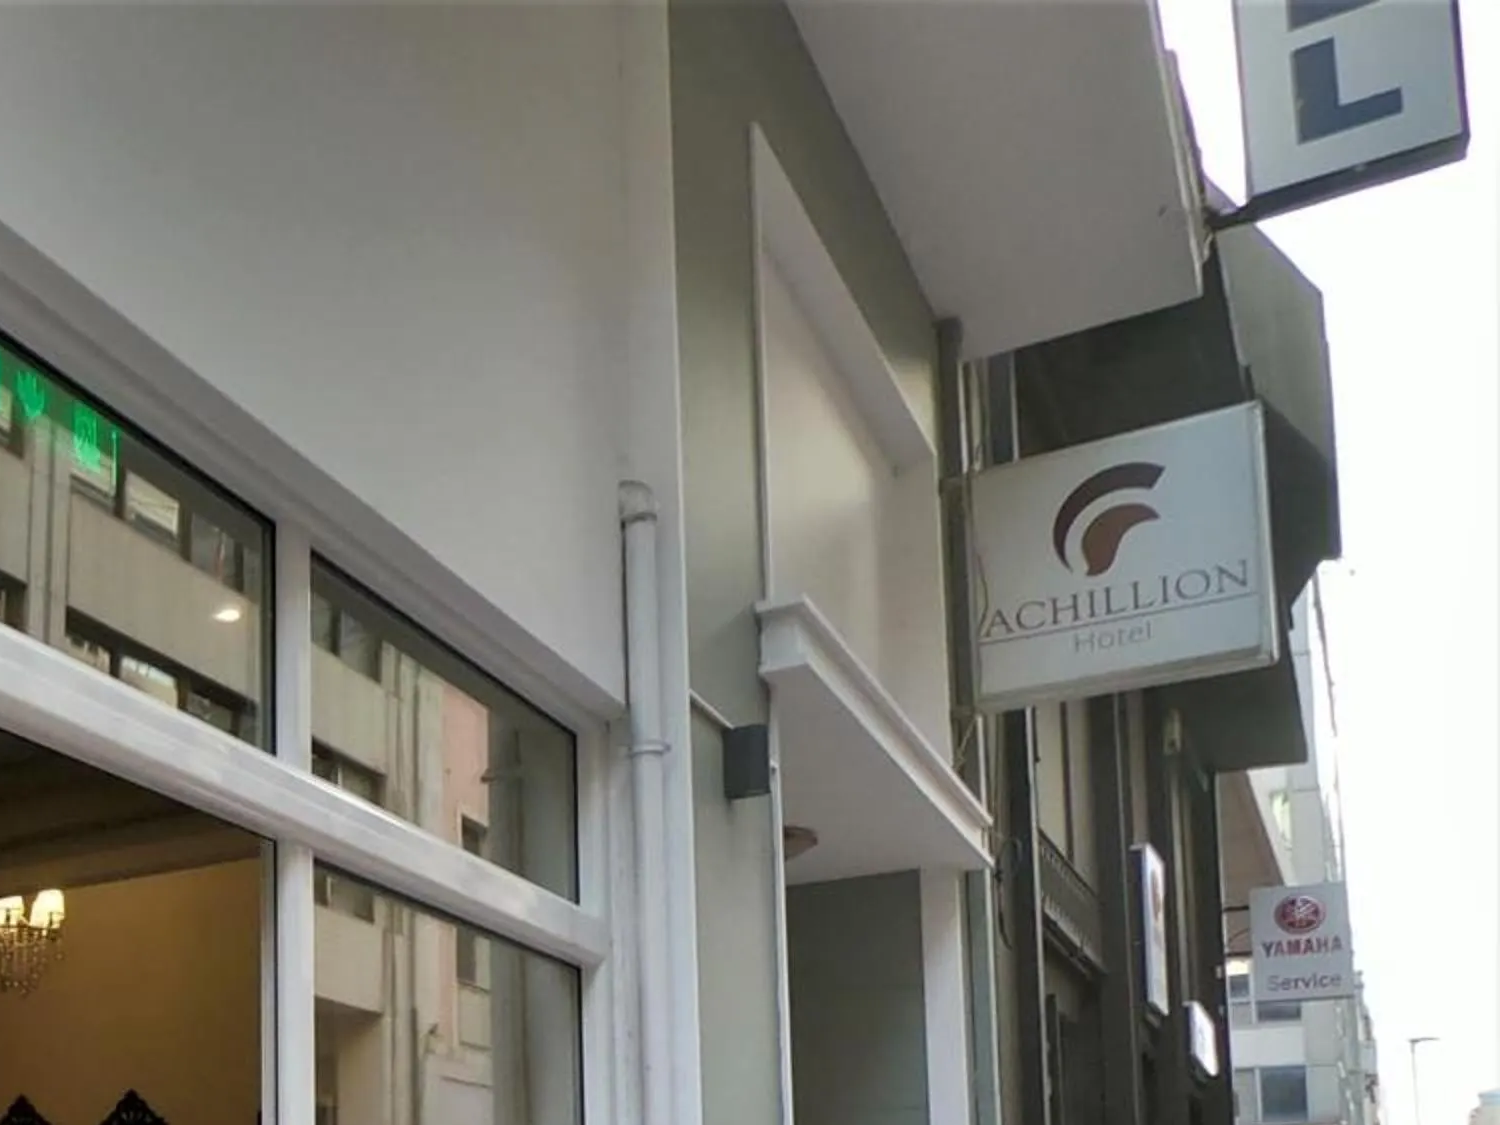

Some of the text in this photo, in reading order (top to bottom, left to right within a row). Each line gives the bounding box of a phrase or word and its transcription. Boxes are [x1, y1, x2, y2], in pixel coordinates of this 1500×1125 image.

[984, 558, 1250, 638] ACHILLION
[1073, 620, 1152, 653] Hotel
[1261, 935, 1344, 958] YAMAHA
[1267, 972, 1342, 991] Service
